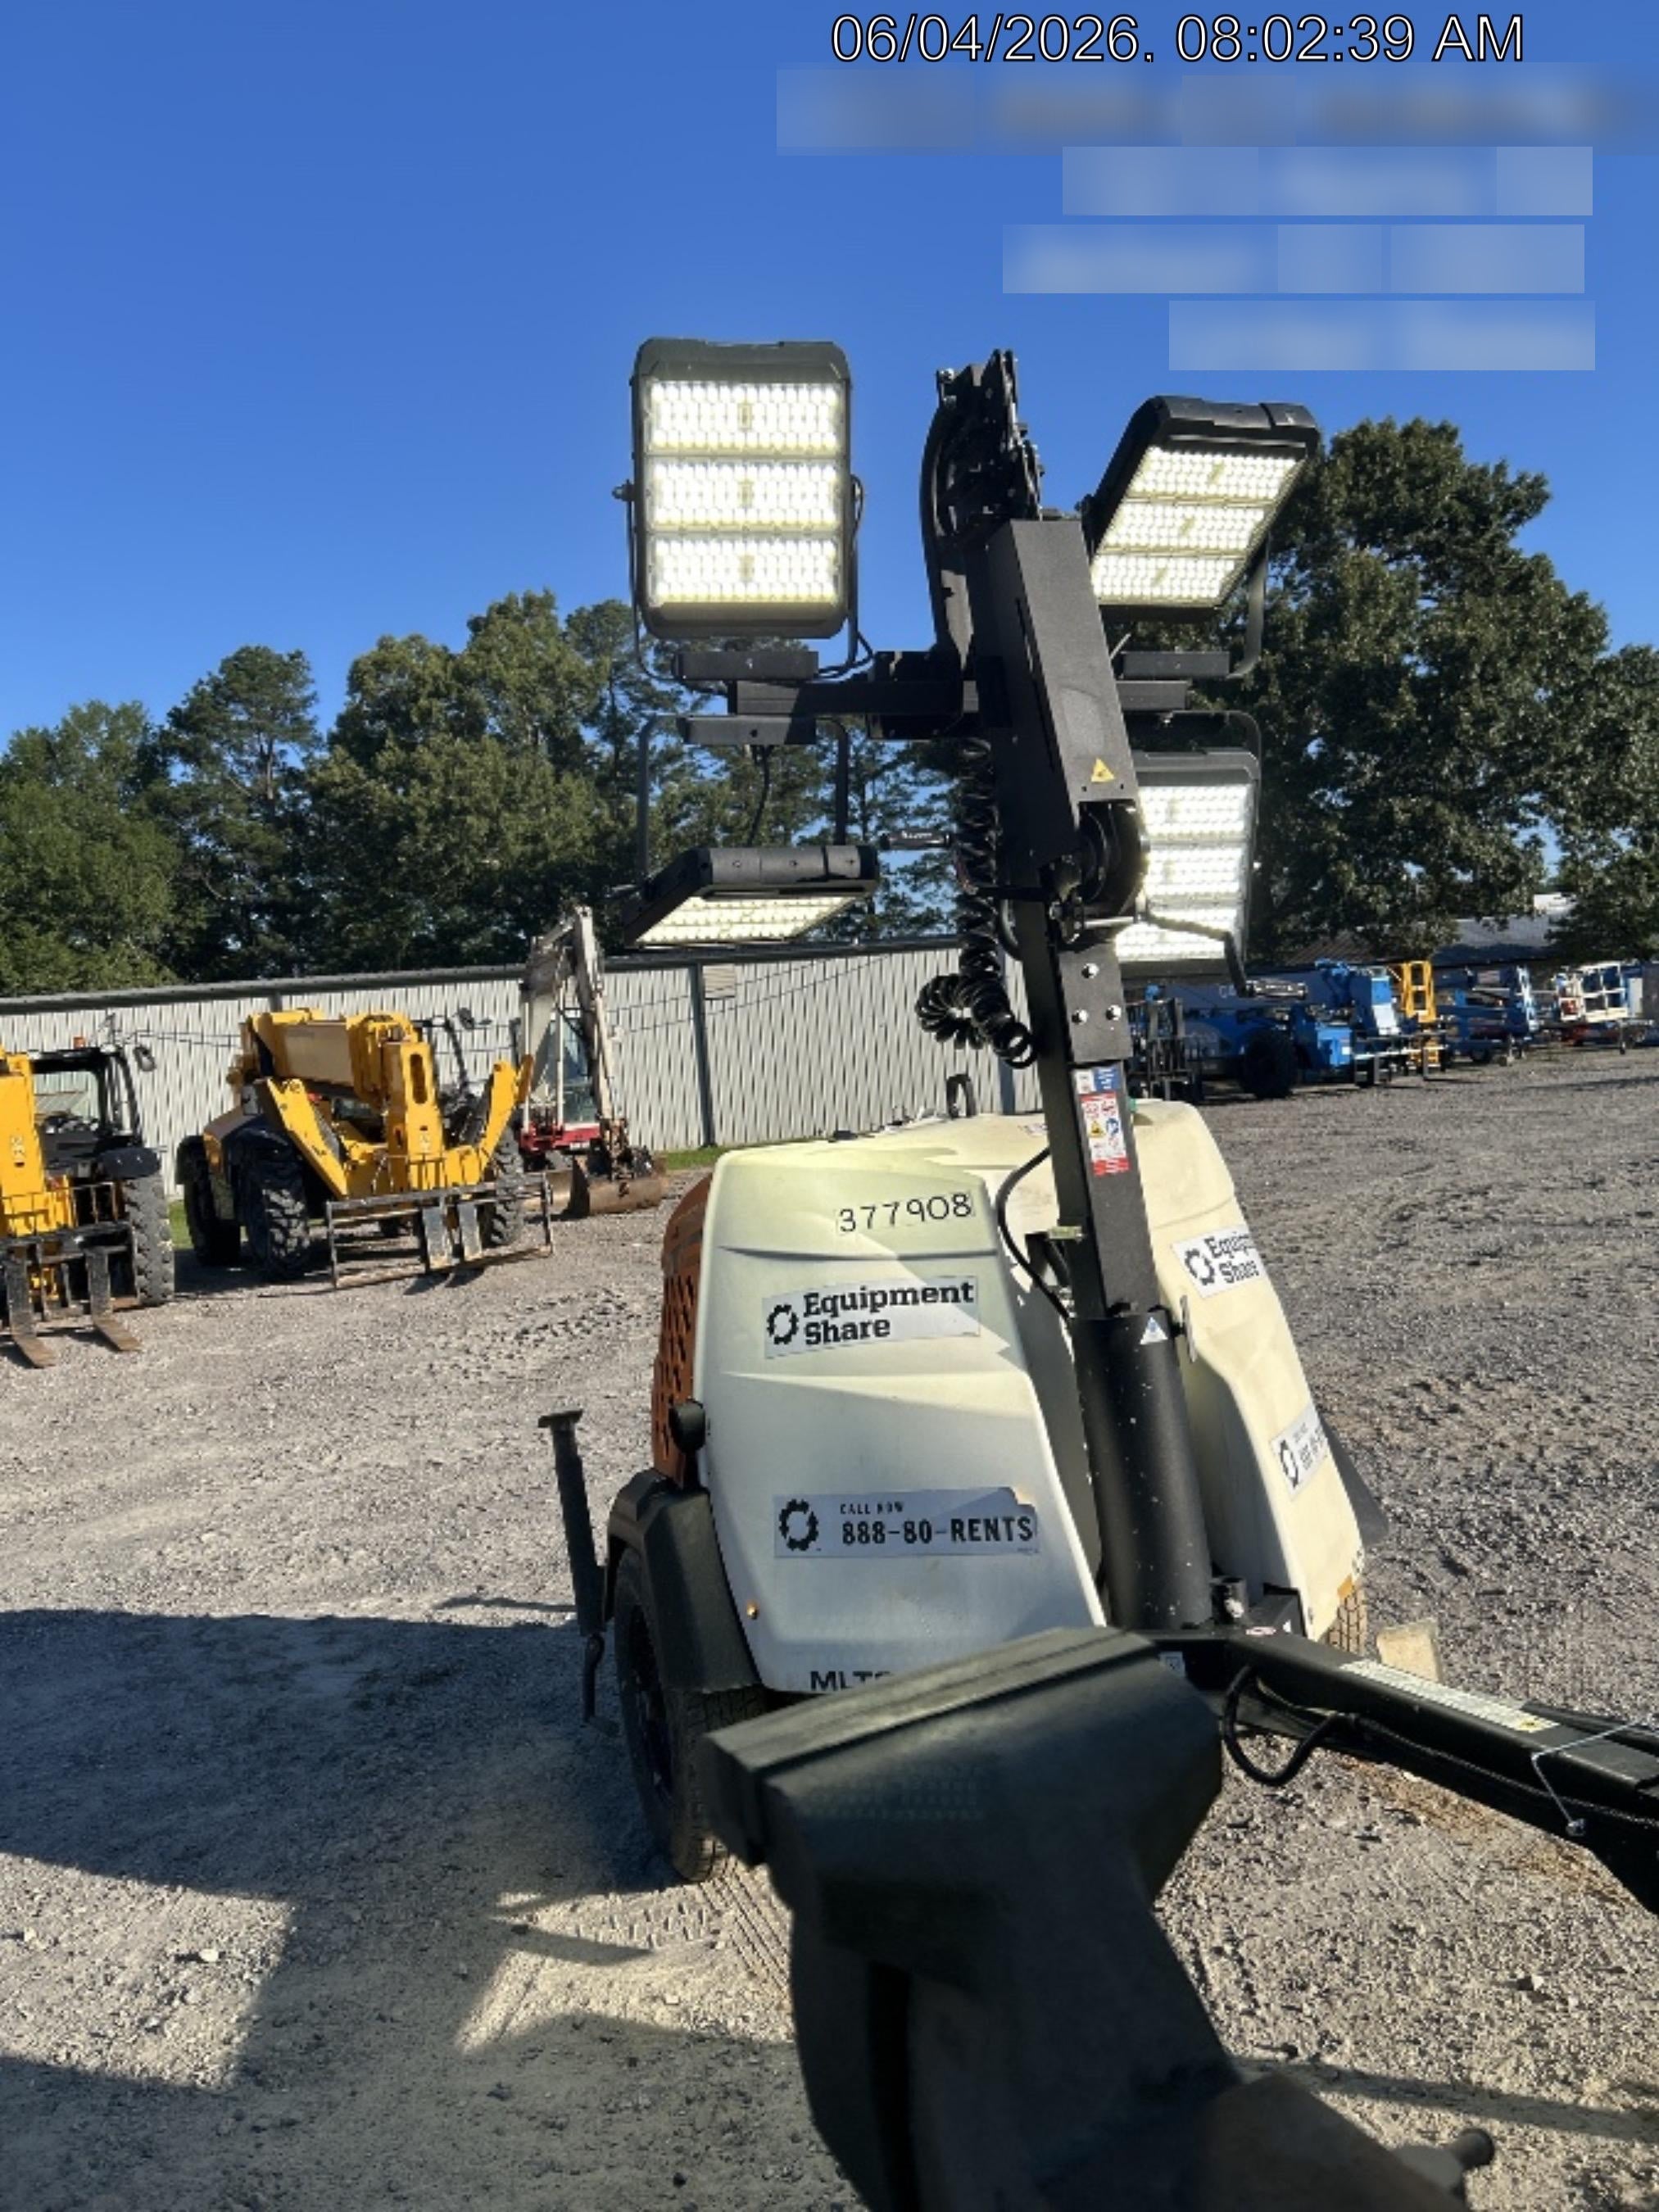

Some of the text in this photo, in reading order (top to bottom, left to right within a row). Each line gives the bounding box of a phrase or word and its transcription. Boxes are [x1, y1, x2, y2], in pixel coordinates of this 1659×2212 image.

[839, 1193, 972, 1232] 377908
[804, 1281, 973, 1318] Equipment
[805, 1319, 891, 1345] Share
[840, 1503, 871, 1515] CALL
[841, 1517, 1033, 1544] 888-80-RENTS
[810, 1670, 893, 1691] MLT
